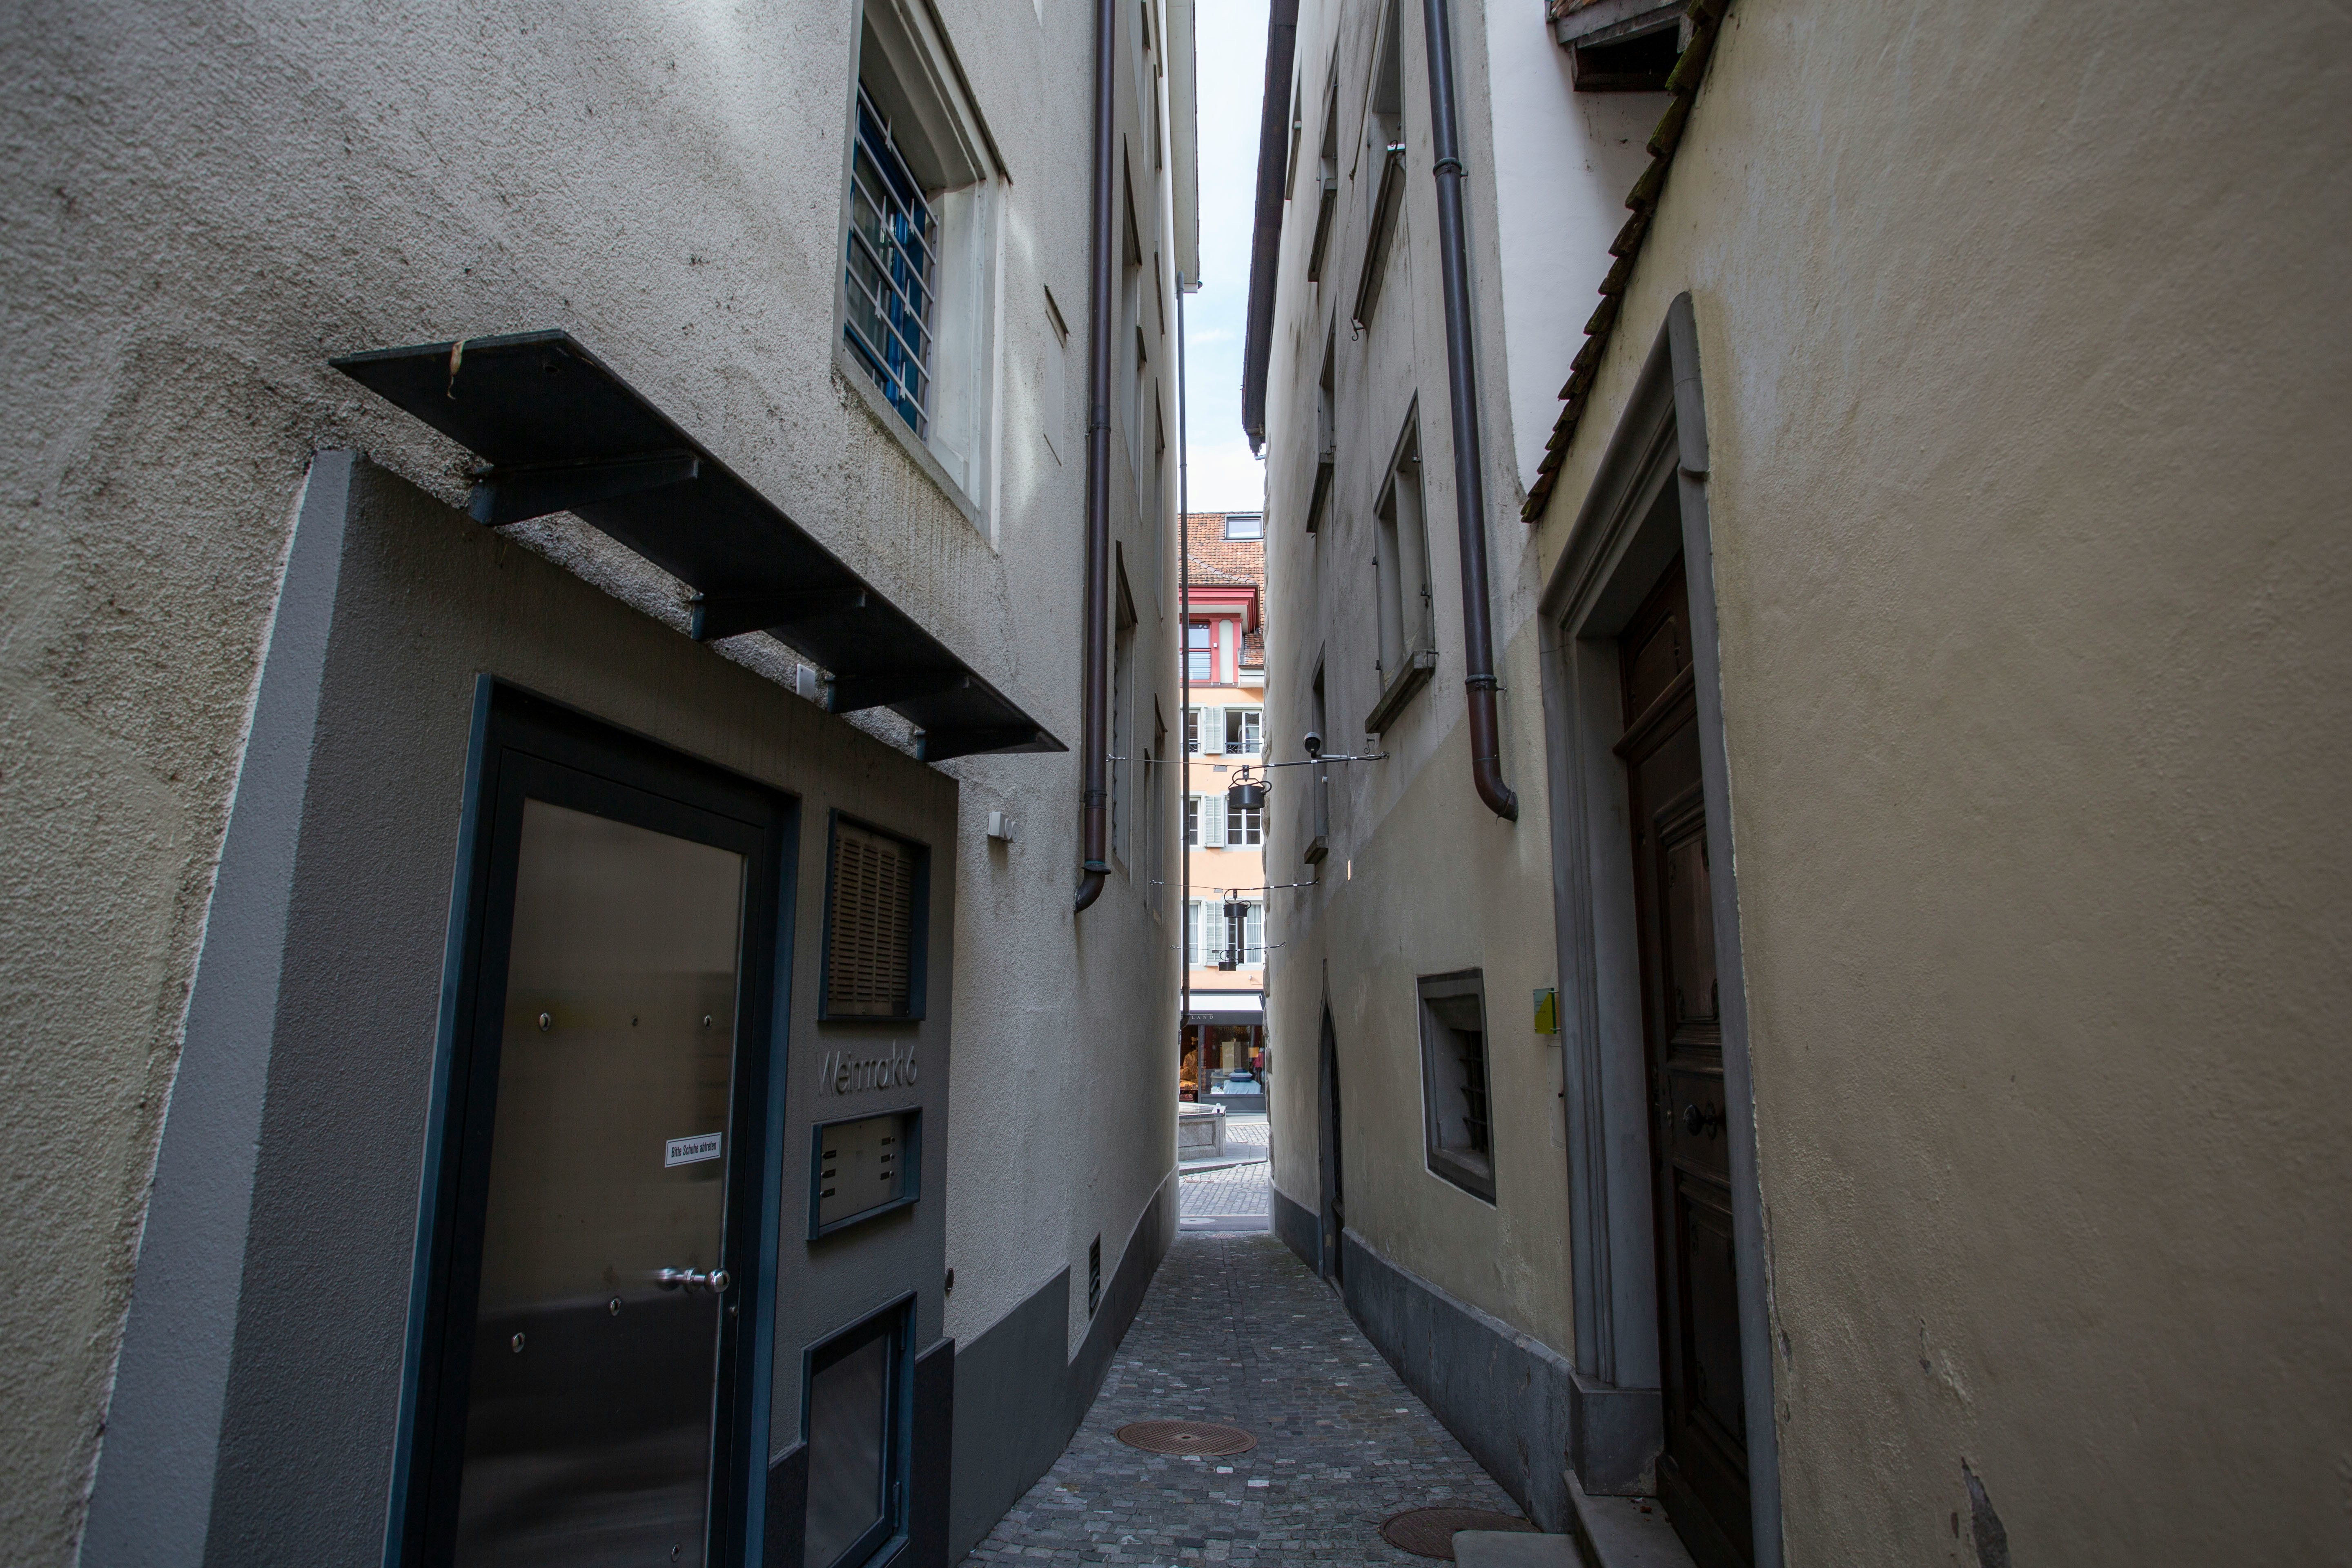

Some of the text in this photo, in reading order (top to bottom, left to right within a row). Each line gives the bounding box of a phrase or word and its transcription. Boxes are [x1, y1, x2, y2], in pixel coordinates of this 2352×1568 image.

[817, 1039, 917, 1096] Weinmarkt 6
[671, 1141, 717, 1158] Bitte Schuhe abtreten
